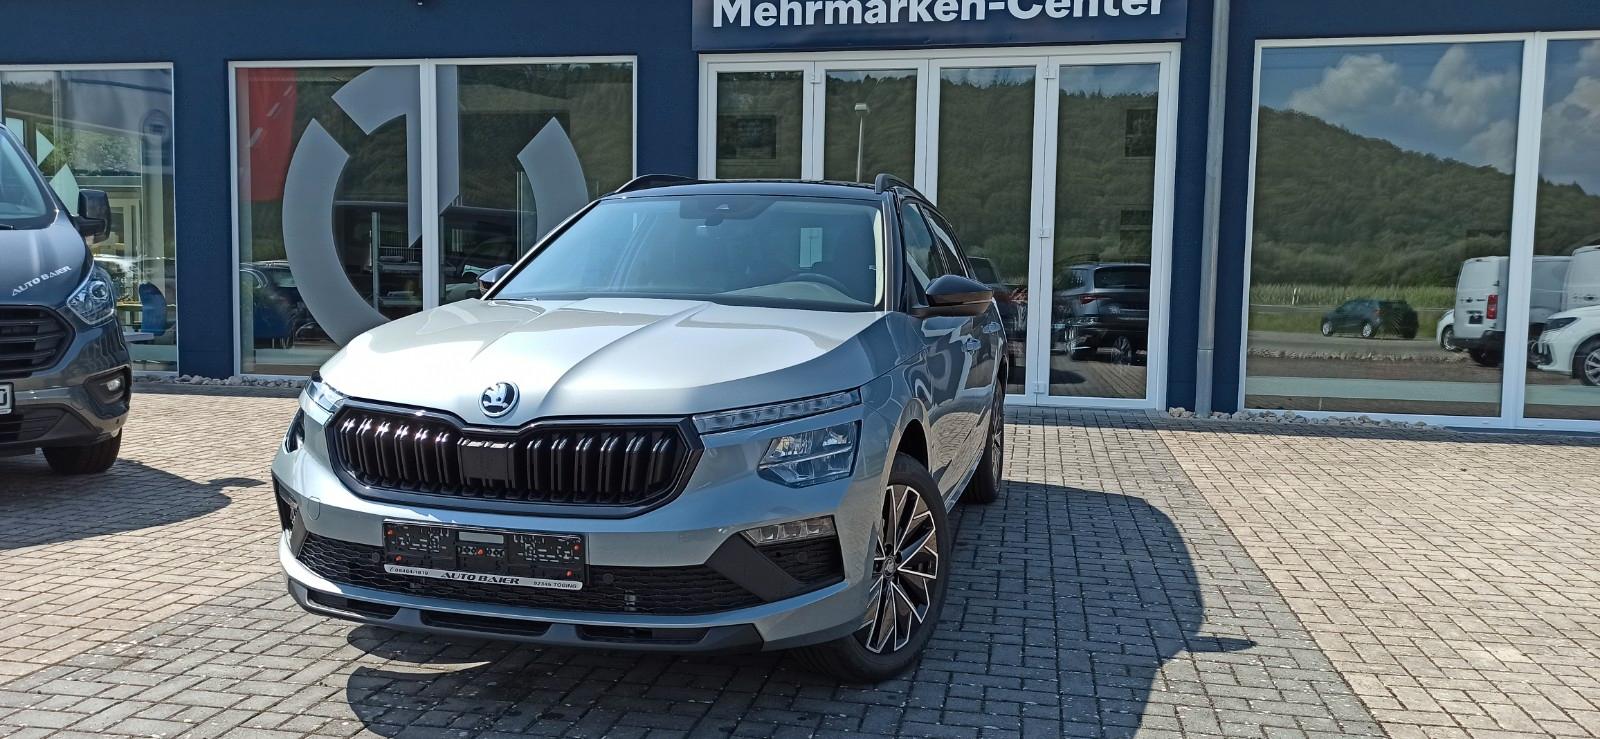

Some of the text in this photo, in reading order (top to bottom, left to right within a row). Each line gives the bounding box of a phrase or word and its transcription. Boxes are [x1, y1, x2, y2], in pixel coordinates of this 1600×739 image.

[712, 0, 1163, 28] Mehrmarken-Center
[11, 265, 72, 297] AUTO BAIER
[441, 572, 520, 585] AUTO BAIER
